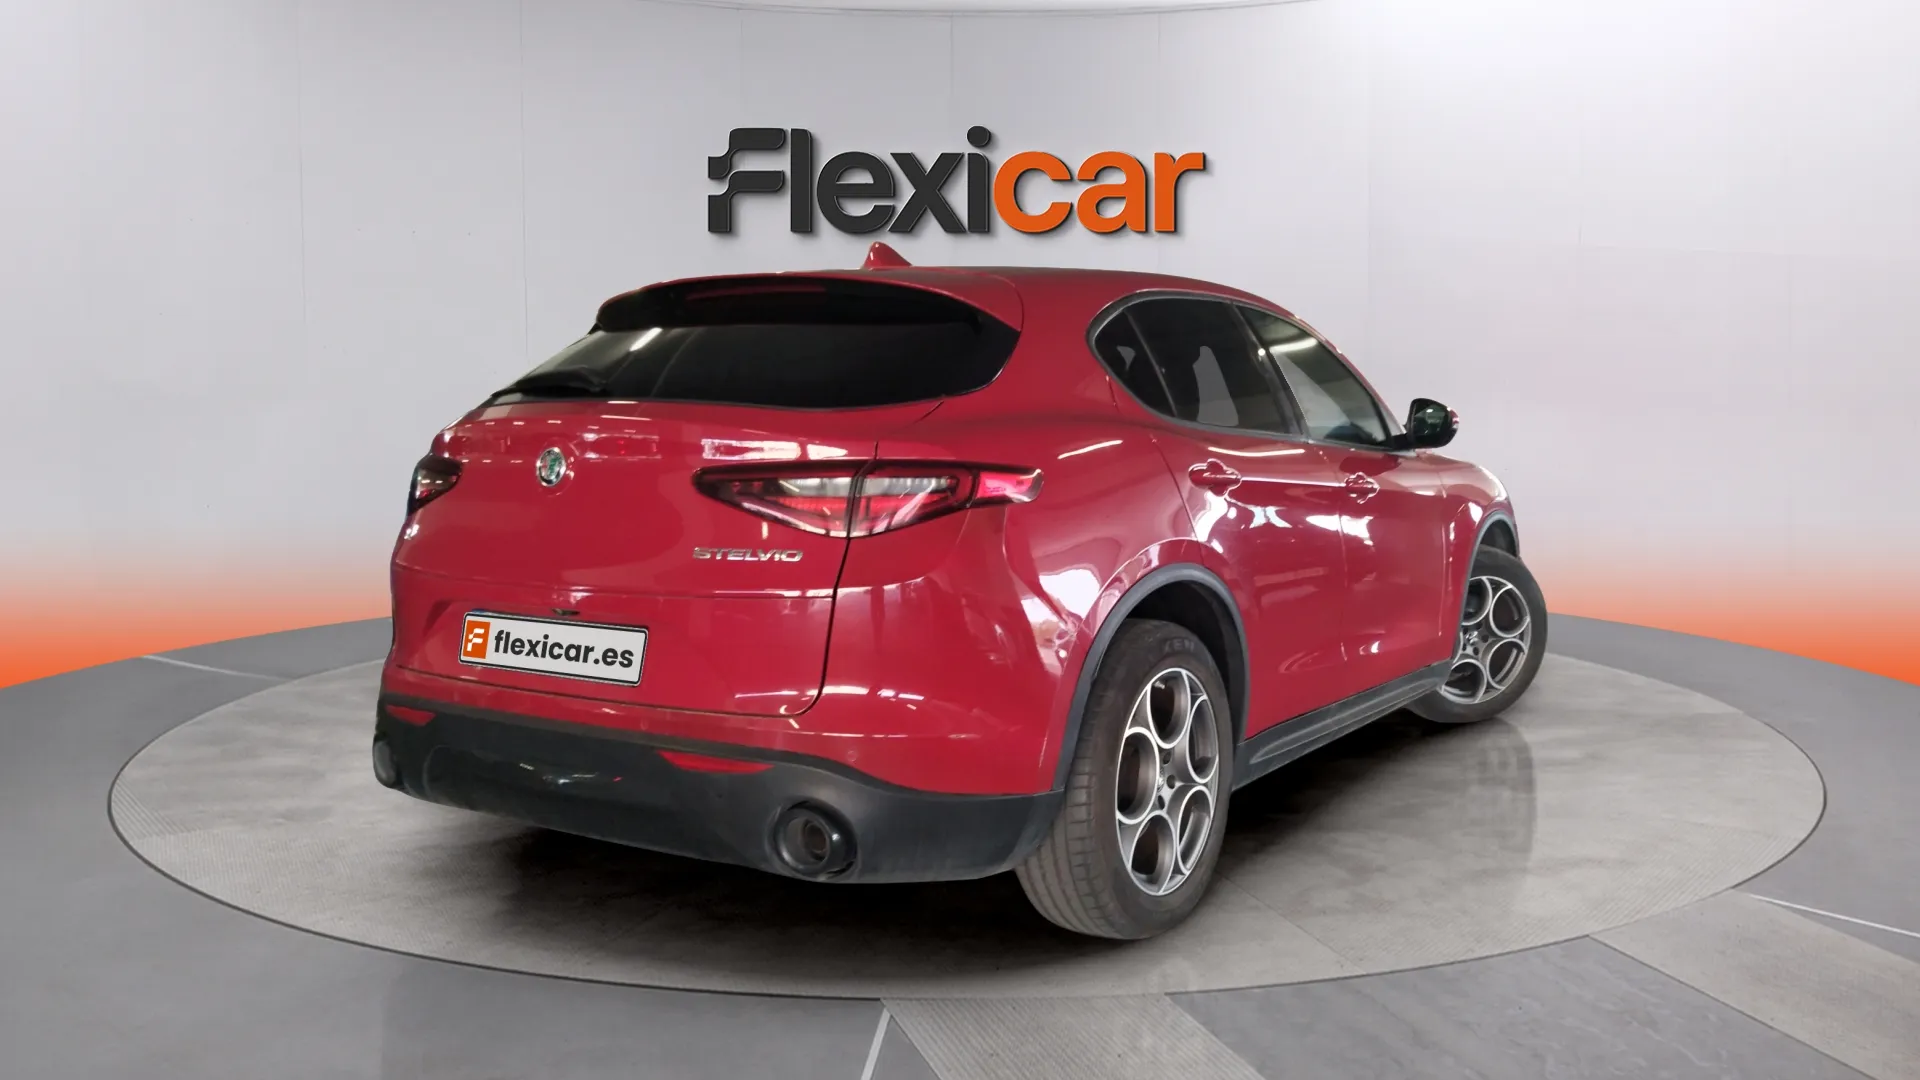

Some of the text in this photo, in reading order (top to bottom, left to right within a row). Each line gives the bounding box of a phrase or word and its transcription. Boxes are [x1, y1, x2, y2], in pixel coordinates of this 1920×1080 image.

[708, 126, 1207, 236] Flexicar
[693, 547, 803, 562] STELVIO
[494, 630, 634, 668] flexicar.es
